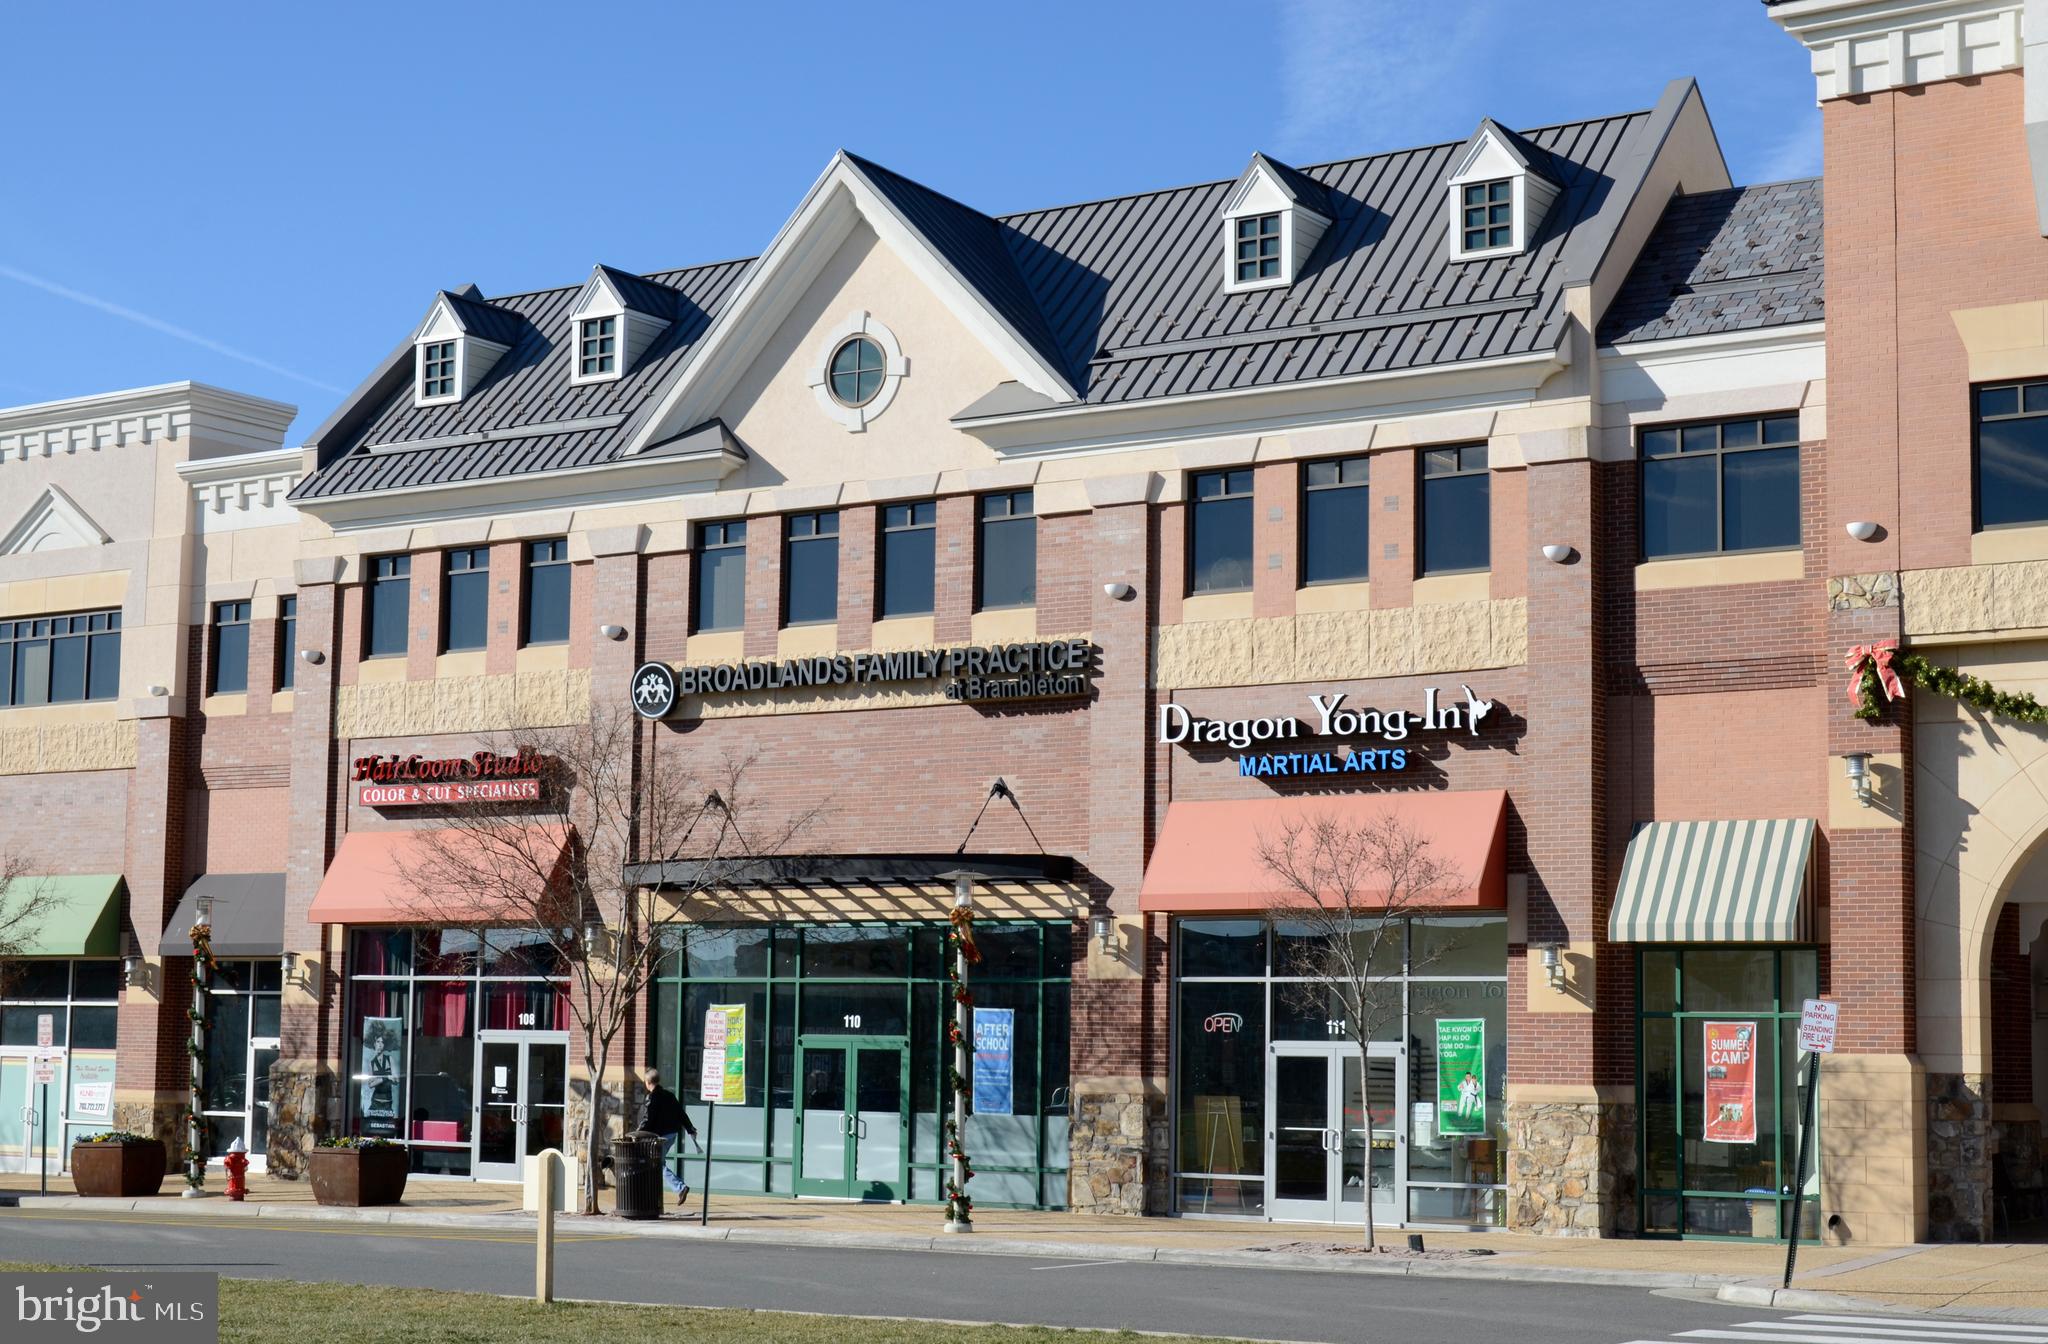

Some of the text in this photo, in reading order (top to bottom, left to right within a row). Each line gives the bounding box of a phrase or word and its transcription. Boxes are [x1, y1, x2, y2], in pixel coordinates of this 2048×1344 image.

[681, 639, 1087, 694] BROADLANDS FAMILY PRACTICE
[945, 674, 1083, 700] at Brambleton
[1159, 687, 1462, 748] Dragon Yong-In
[469, 750, 544, 778] Studio
[1239, 749, 1406, 777] MARTIAL ARTS
[362, 782, 536, 803] COLOR & CUT SPECIALISTS
[1814, 1004, 1827, 1012] NO
[518, 1013, 535, 1026] 108
[843, 1014, 861, 1028] 110
[1805, 1011, 1834, 1021] PARKING
[976, 1023, 1009, 1036] AFTER
[1204, 1016, 1241, 1032] OPEN
[1326, 1019, 1345, 1034] 111
[1803, 1024, 1833, 1034] STANDING
[726, 1028, 742, 1037] RTY
[1802, 1032, 1832, 1043] FIRE LANE
[976, 1037, 1009, 1050] SCHOOL
[1711, 1039, 1750, 1050] SUMMER
[1711, 1051, 1750, 1065] CAMP
